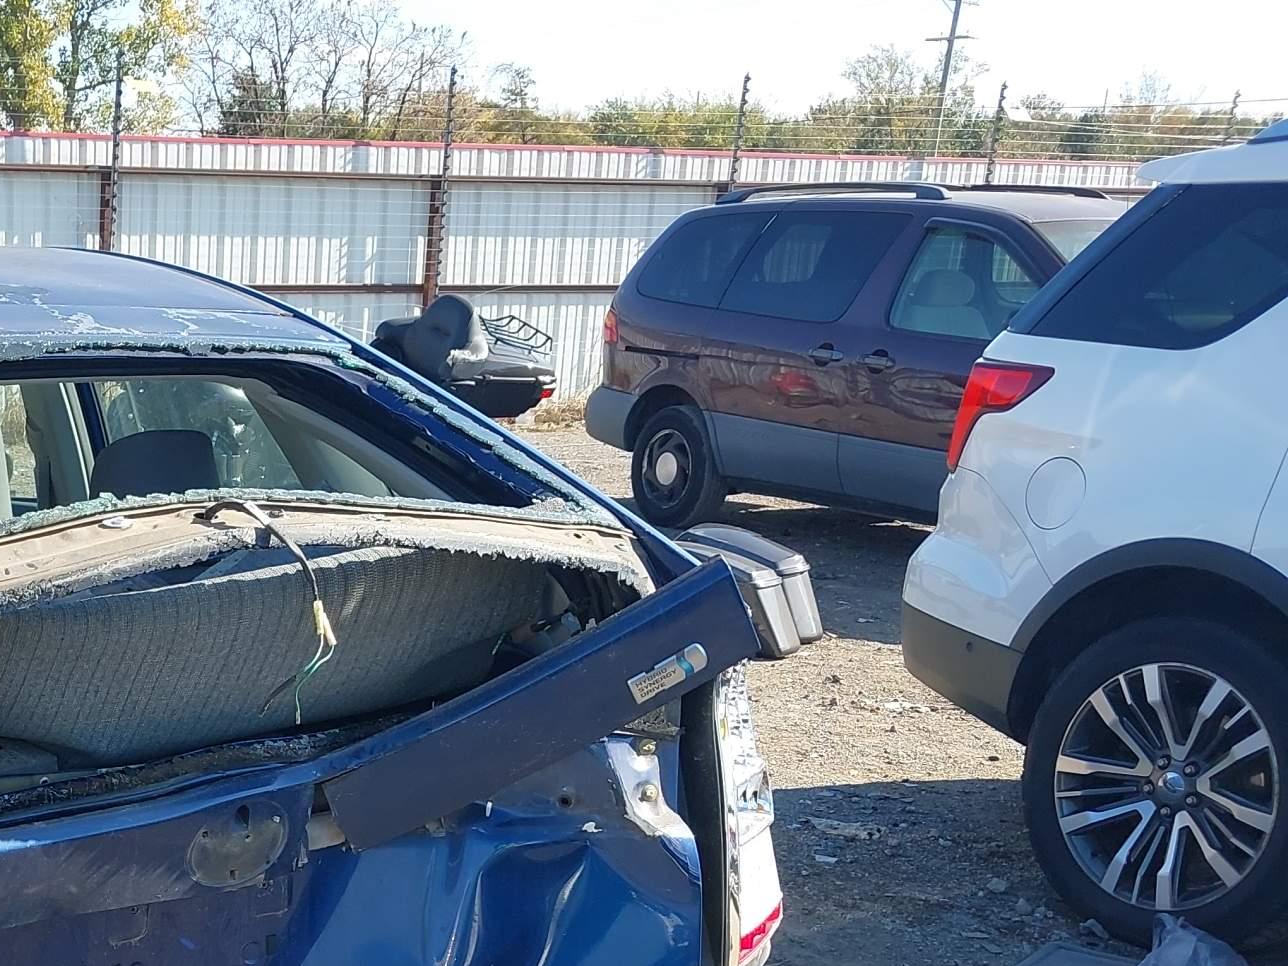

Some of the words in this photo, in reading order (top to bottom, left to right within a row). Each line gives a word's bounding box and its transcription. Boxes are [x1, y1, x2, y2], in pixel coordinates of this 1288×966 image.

[635, 668, 668, 688] HYBRID
[638, 669, 677, 693] SYNERGY
[640, 682, 667, 698] DRIVE
